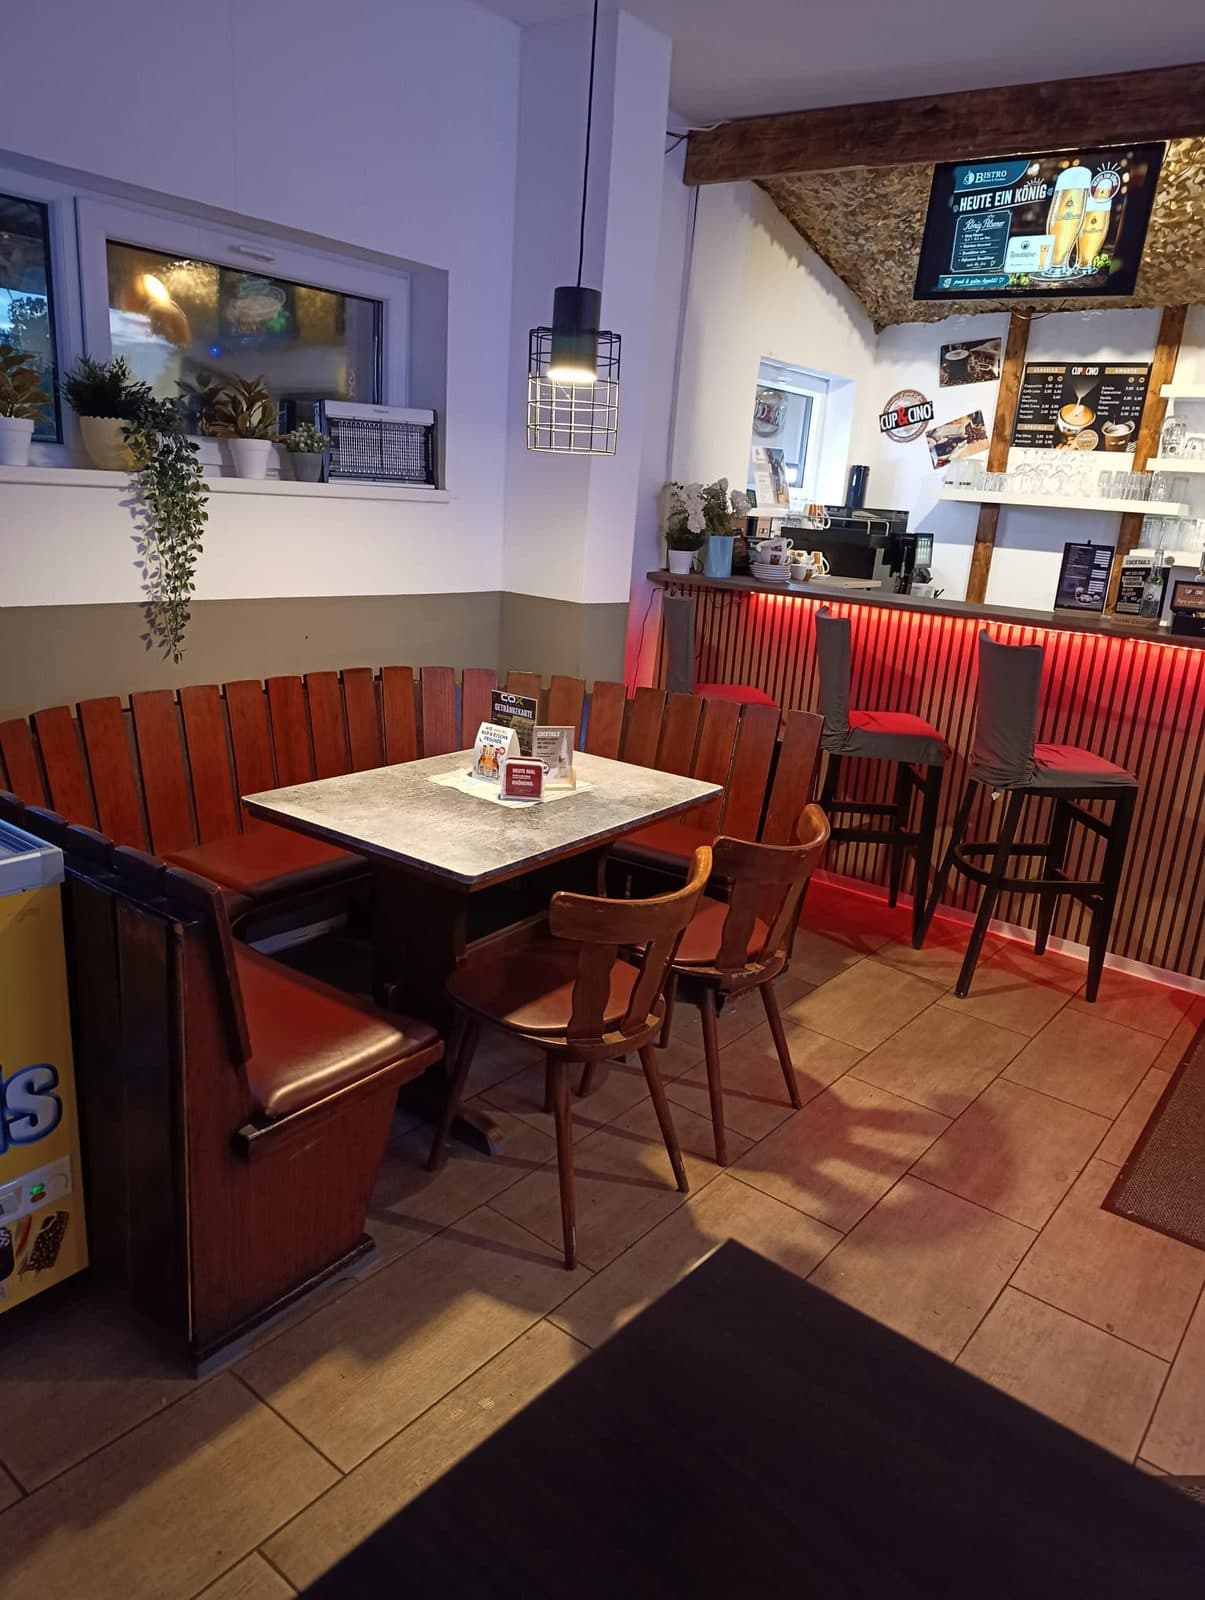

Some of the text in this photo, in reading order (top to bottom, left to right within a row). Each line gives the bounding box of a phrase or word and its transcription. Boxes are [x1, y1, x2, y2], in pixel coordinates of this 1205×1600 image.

[960, 184, 1048, 212] HEUTE EIN KÖNIG
[500, 693, 524, 706] COX
